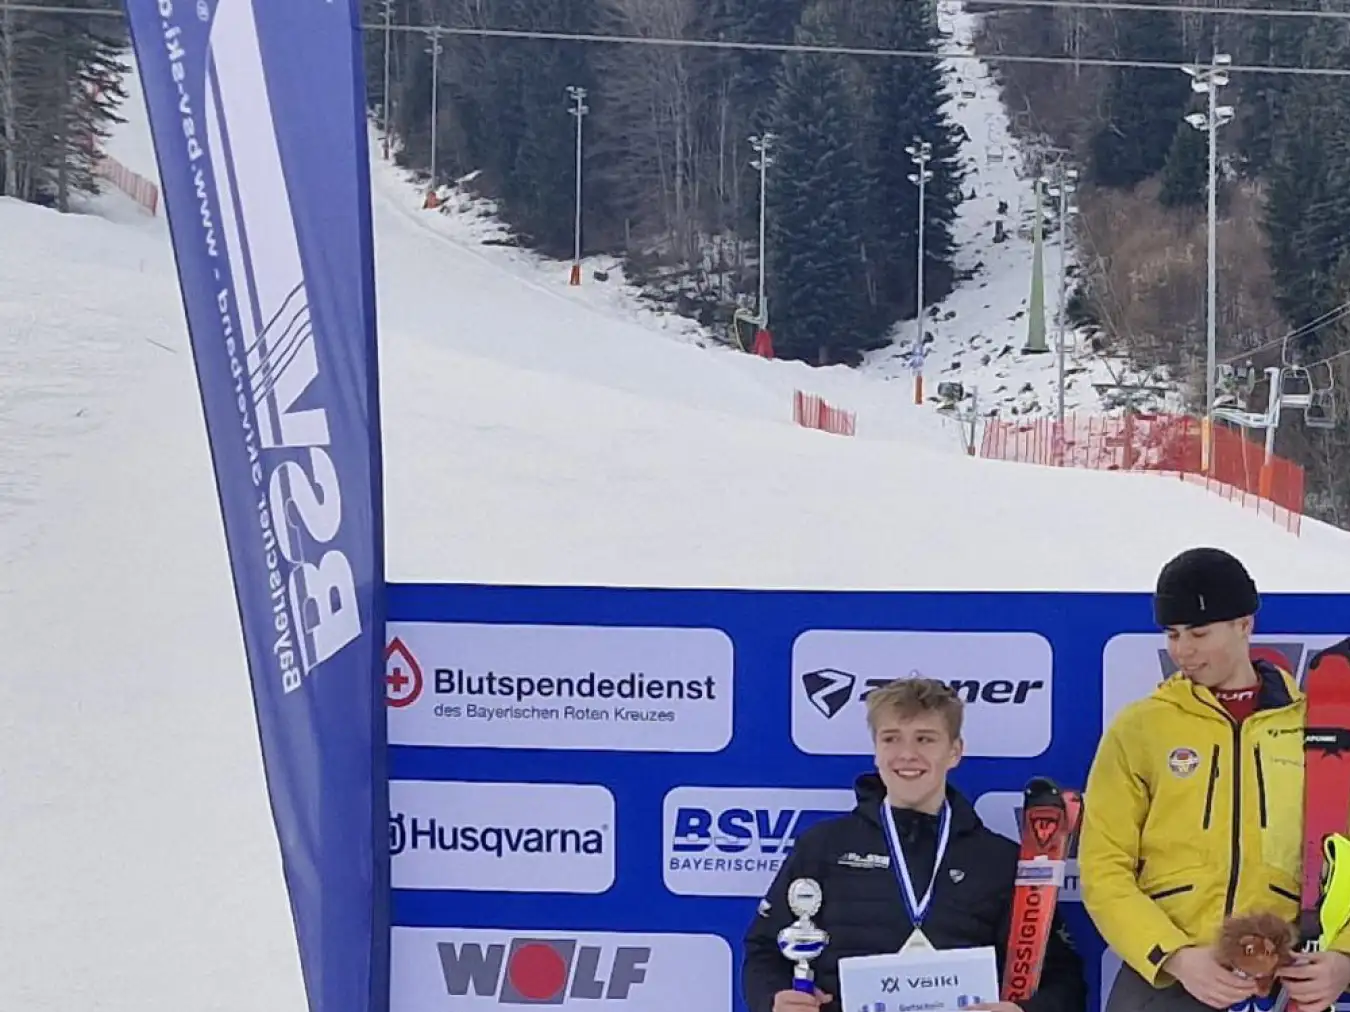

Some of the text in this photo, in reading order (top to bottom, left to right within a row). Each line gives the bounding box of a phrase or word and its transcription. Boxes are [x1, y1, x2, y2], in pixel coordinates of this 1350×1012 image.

[434, 668, 716, 701] Blutspendedienst
[434, 704, 675, 722] des Bayerischen Roten Kreuzes
[411, 823, 603, 855] Husqvarna
